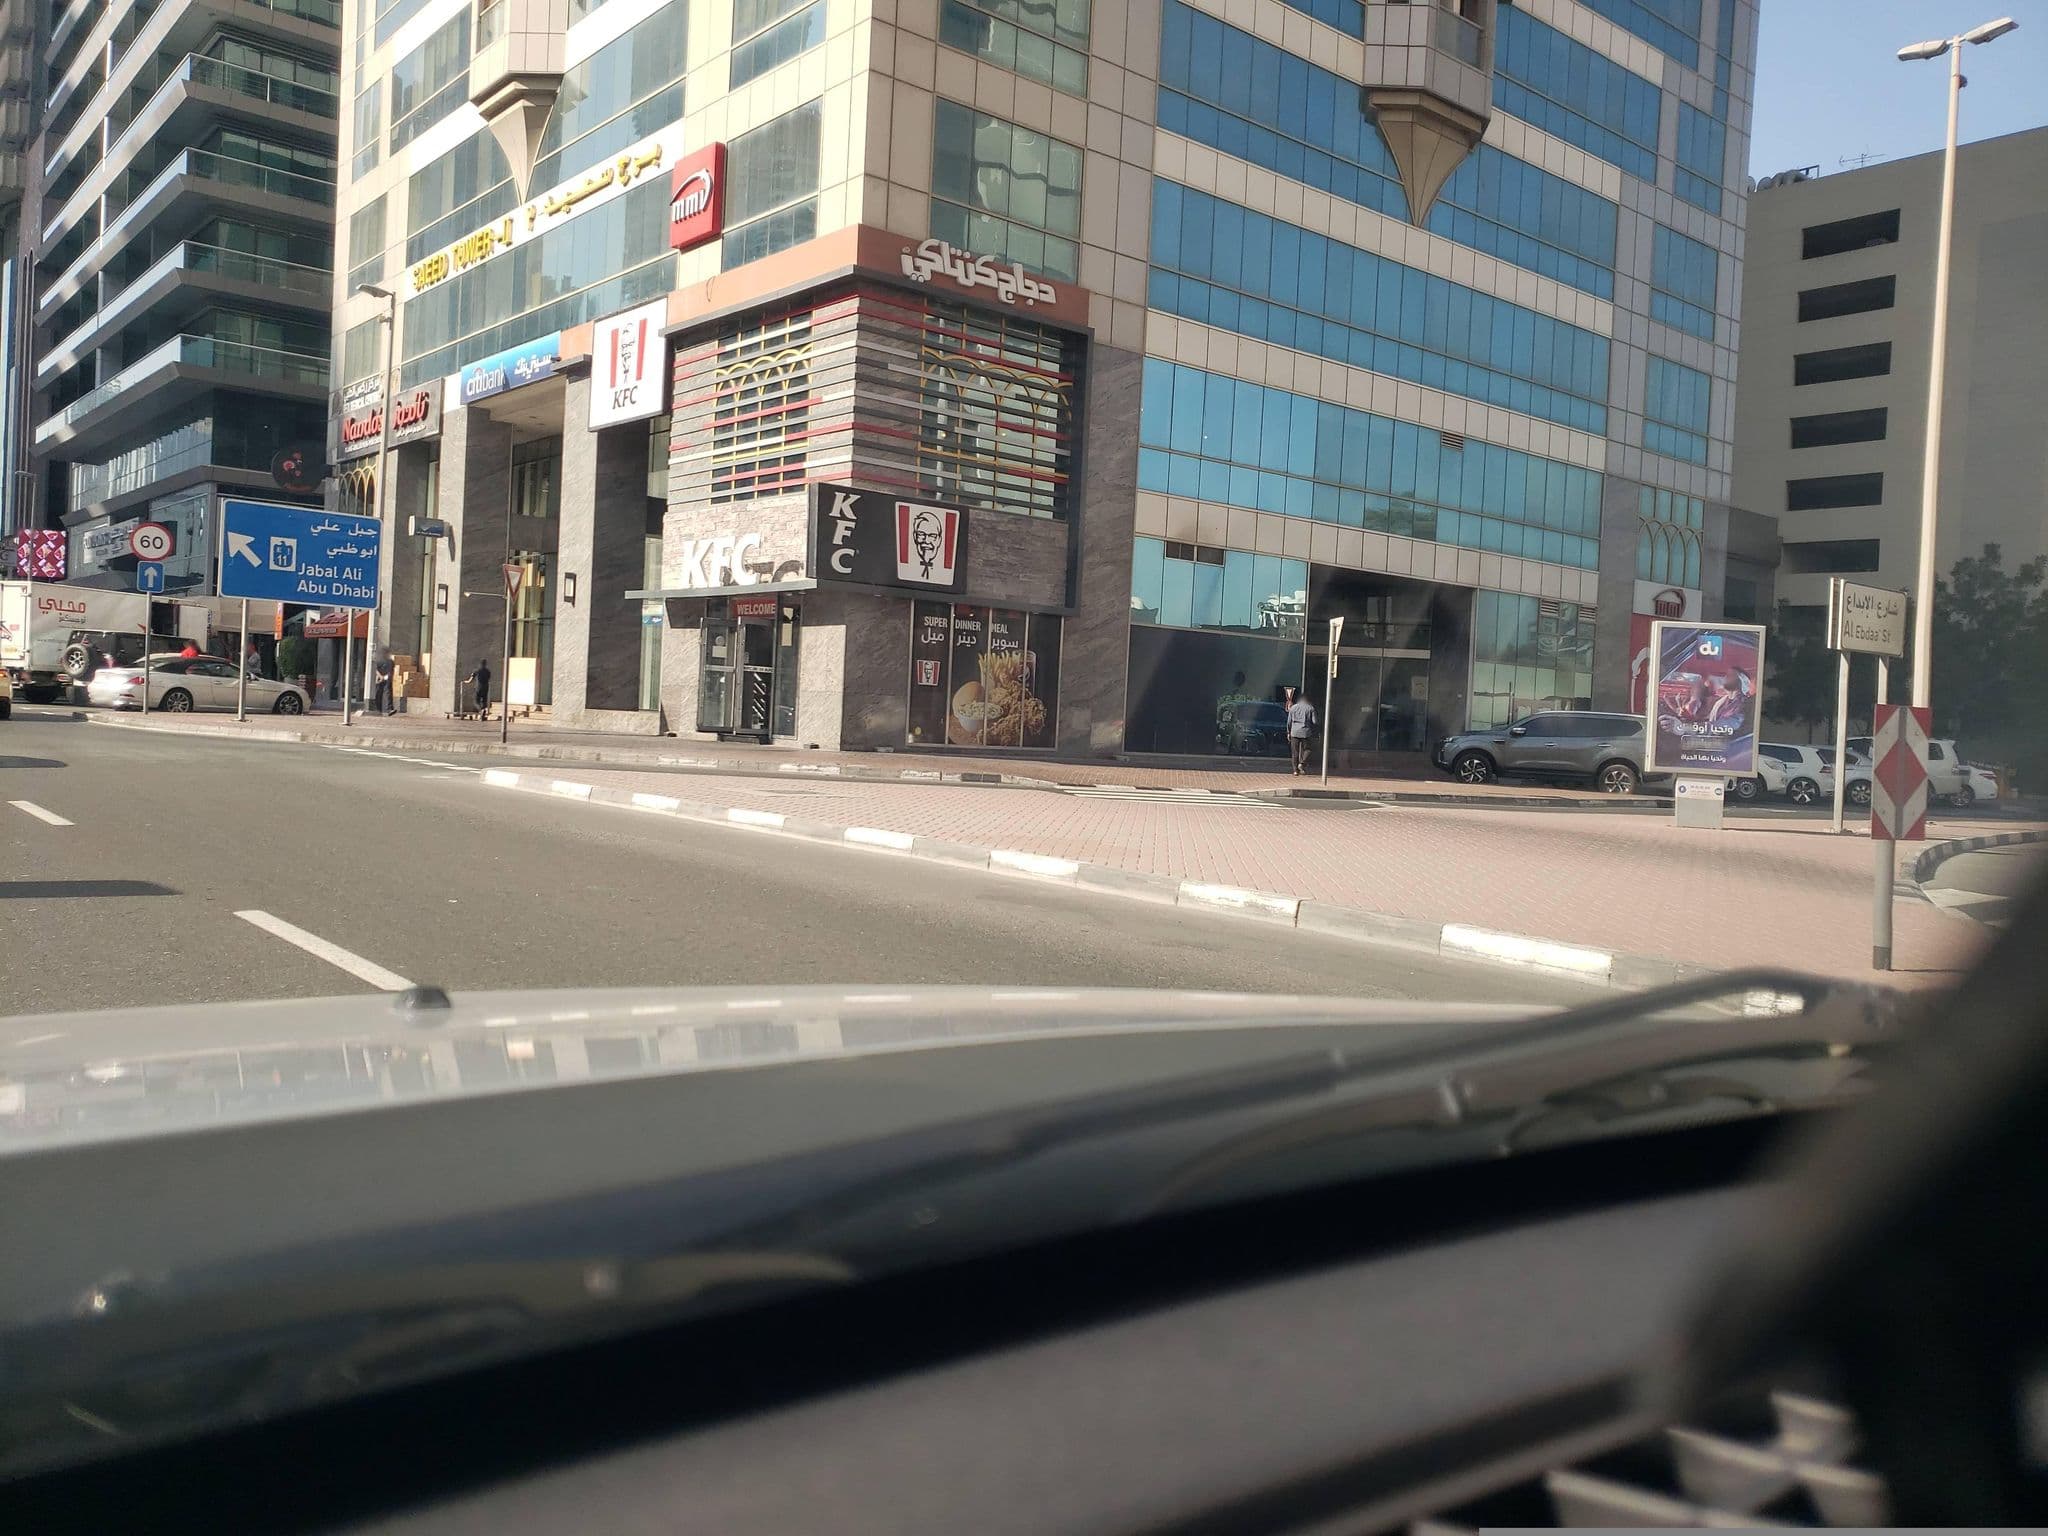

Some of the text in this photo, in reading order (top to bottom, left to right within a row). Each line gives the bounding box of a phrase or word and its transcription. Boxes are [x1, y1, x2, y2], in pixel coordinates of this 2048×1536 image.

[545, 167, 614, 217] سعيد
[413, 252, 449, 292] SAEED
[901, 238, 1057, 306] دجاج كنتاكي
[612, 386, 638, 410] KFC
[310, 518, 378, 539] جبل علي
[829, 491, 861, 575] KFC
[139, 535, 164, 550] 60
[277, 554, 288, 566] 11
[677, 533, 761, 589] KFC
[298, 562, 363, 581] Jabal Ali
[297, 580, 375, 599] Abu Dhabi
[737, 602, 777, 615] WELCOME
[1877, 598, 1899, 619] شارع
[924, 615, 948, 628] SUPER
[955, 619, 982, 632] DINNER
[1843, 620, 1854, 638] Al
[1881, 629, 1892, 643] St
[921, 626, 1019, 649] سوبر دينر ميل
[1699, 640, 1720, 656] du
